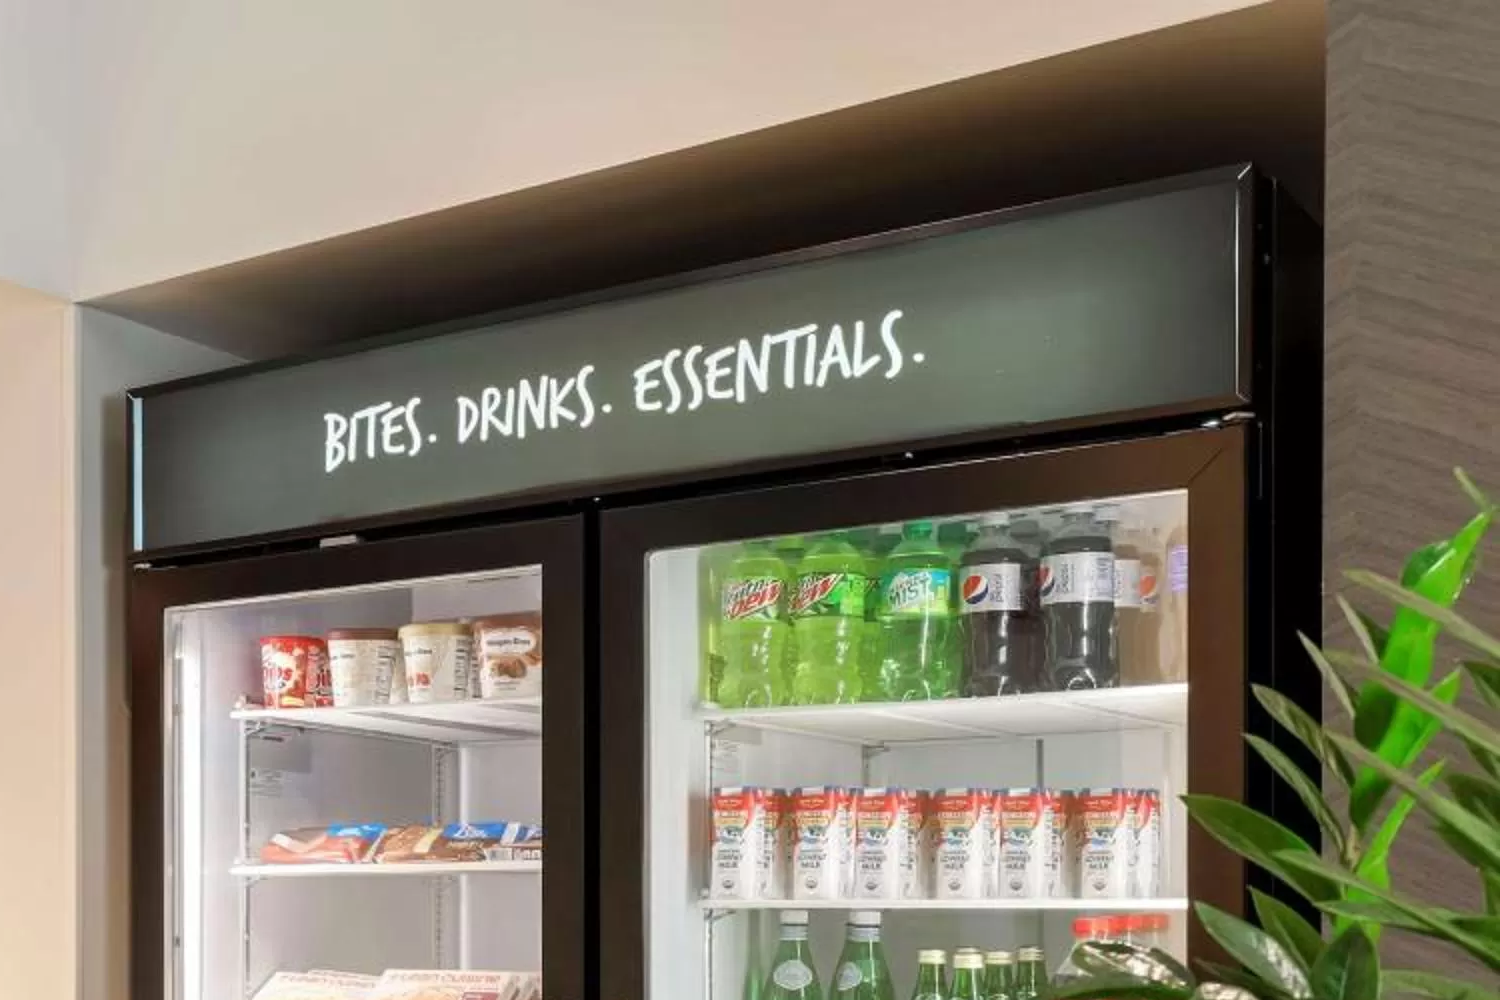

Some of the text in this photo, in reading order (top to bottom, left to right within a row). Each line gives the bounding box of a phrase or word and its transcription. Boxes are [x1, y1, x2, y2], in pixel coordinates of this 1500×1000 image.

[324, 309, 926, 472] BITES. DRINKS. ESSENTIALS.
